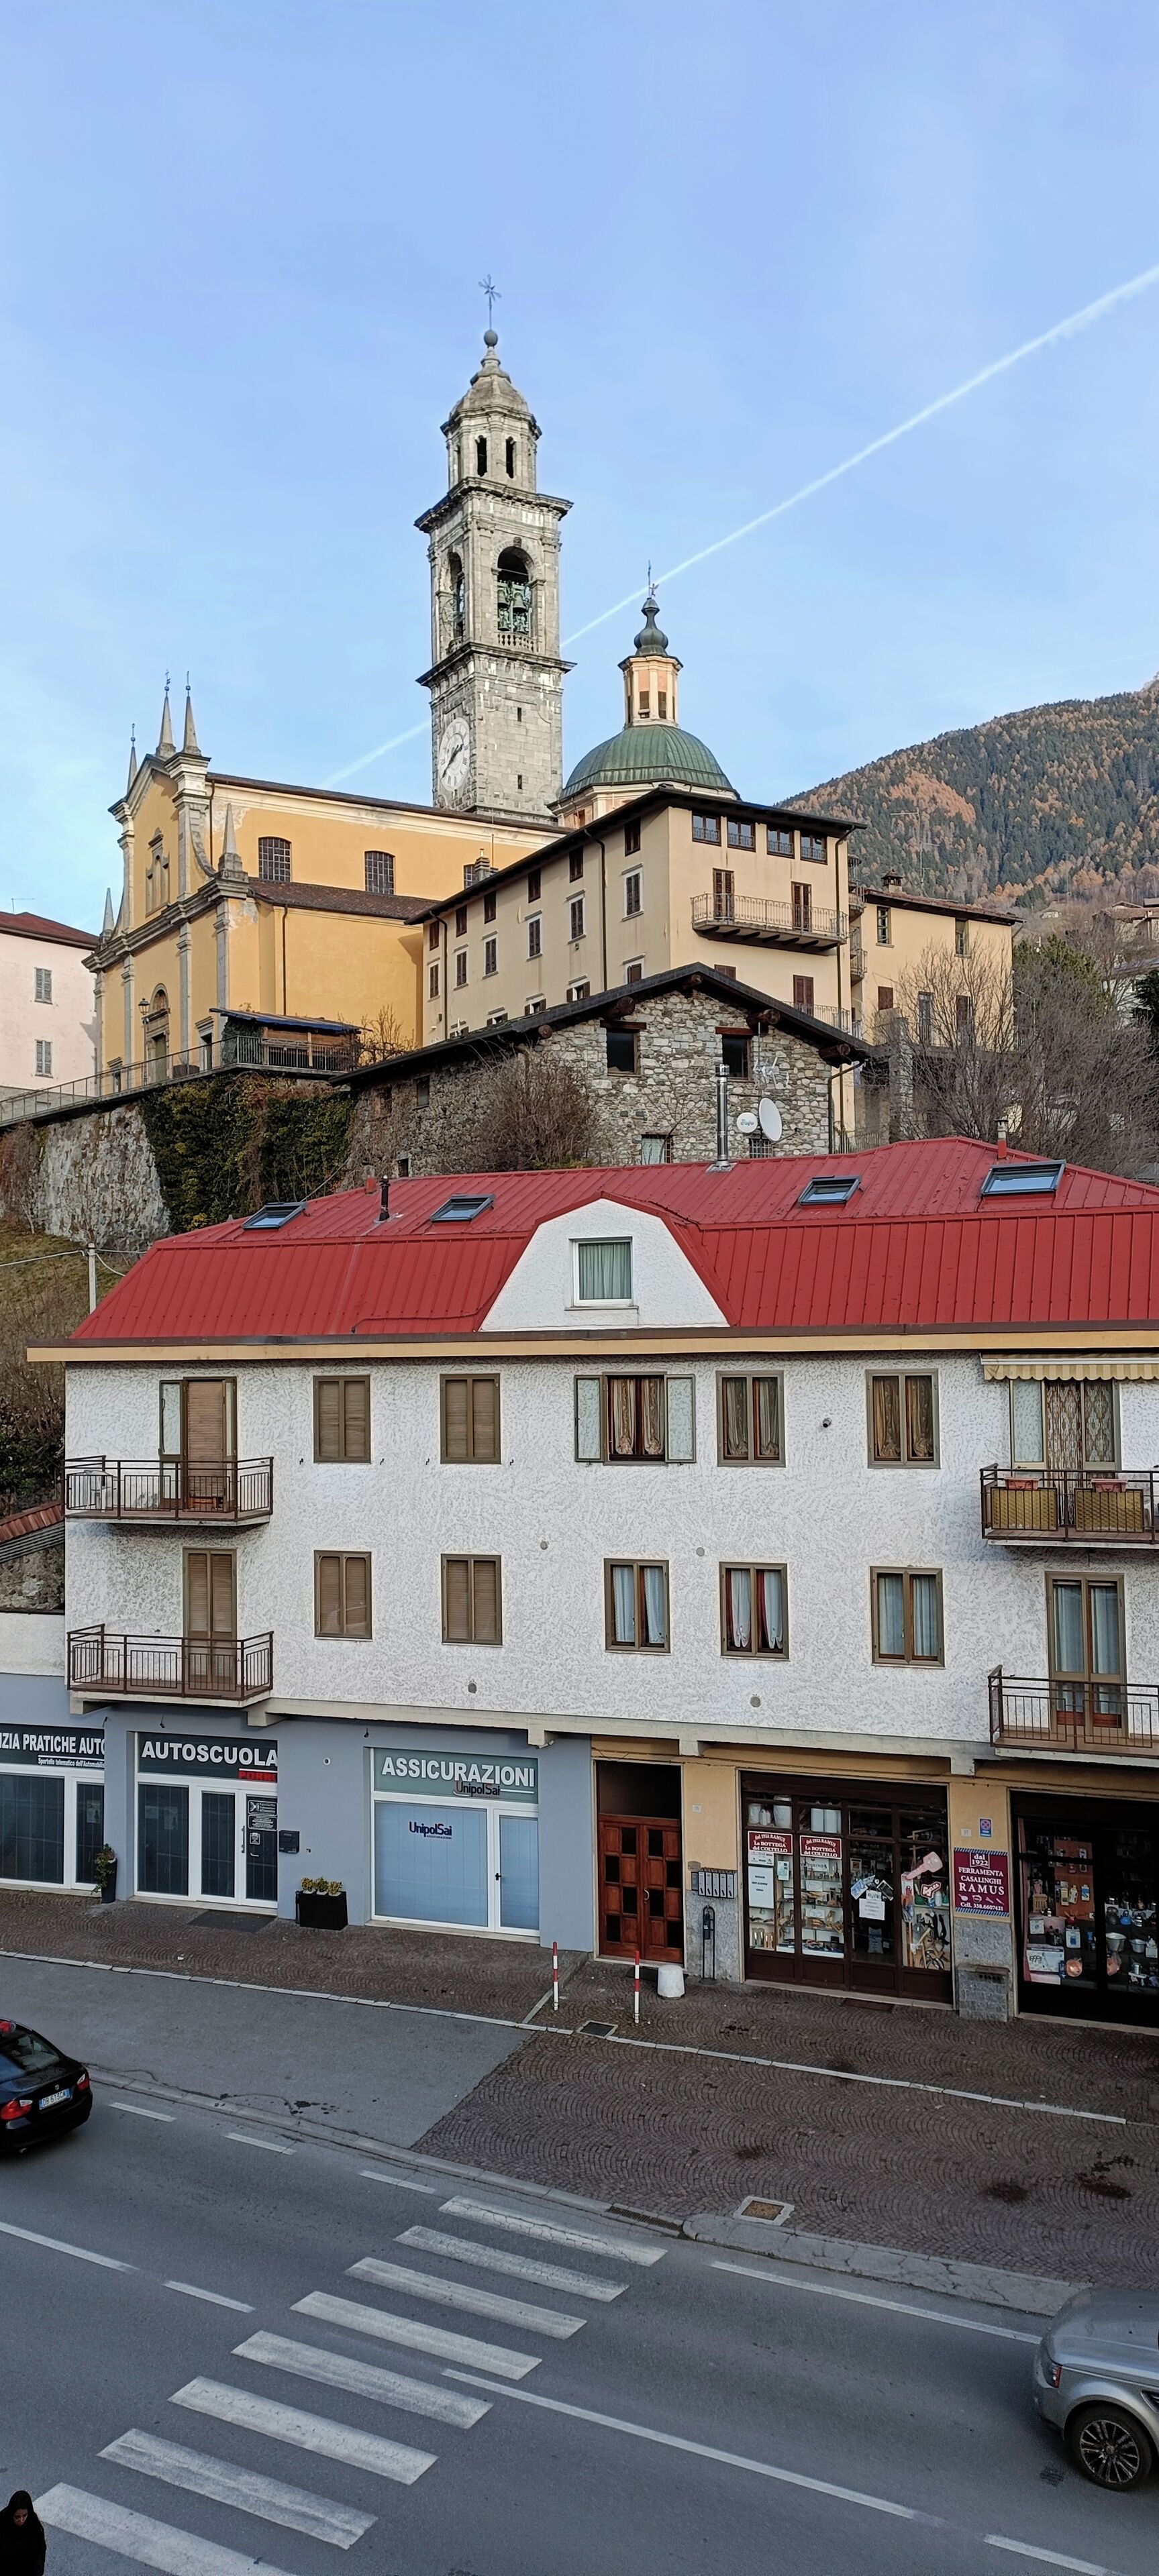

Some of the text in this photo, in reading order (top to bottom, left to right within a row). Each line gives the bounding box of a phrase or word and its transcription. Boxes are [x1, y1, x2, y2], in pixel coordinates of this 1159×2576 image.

[23, 1733, 77, 1754] PRATICHE
[38, 1758, 55, 1766] Sportello
[142, 1741, 277, 1767] AUTOSCUOLA
[382, 1757, 535, 1787] ASSICURAZIONI
[455, 1781, 500, 1797] UnipolSai
[409, 1821, 452, 1837] UnipolSai
[958, 1867, 1004, 1877] FERRAMENTA
[960, 1875, 1002, 1885] CASALINGHI
[958, 1882, 1005, 1895] RAMUS
